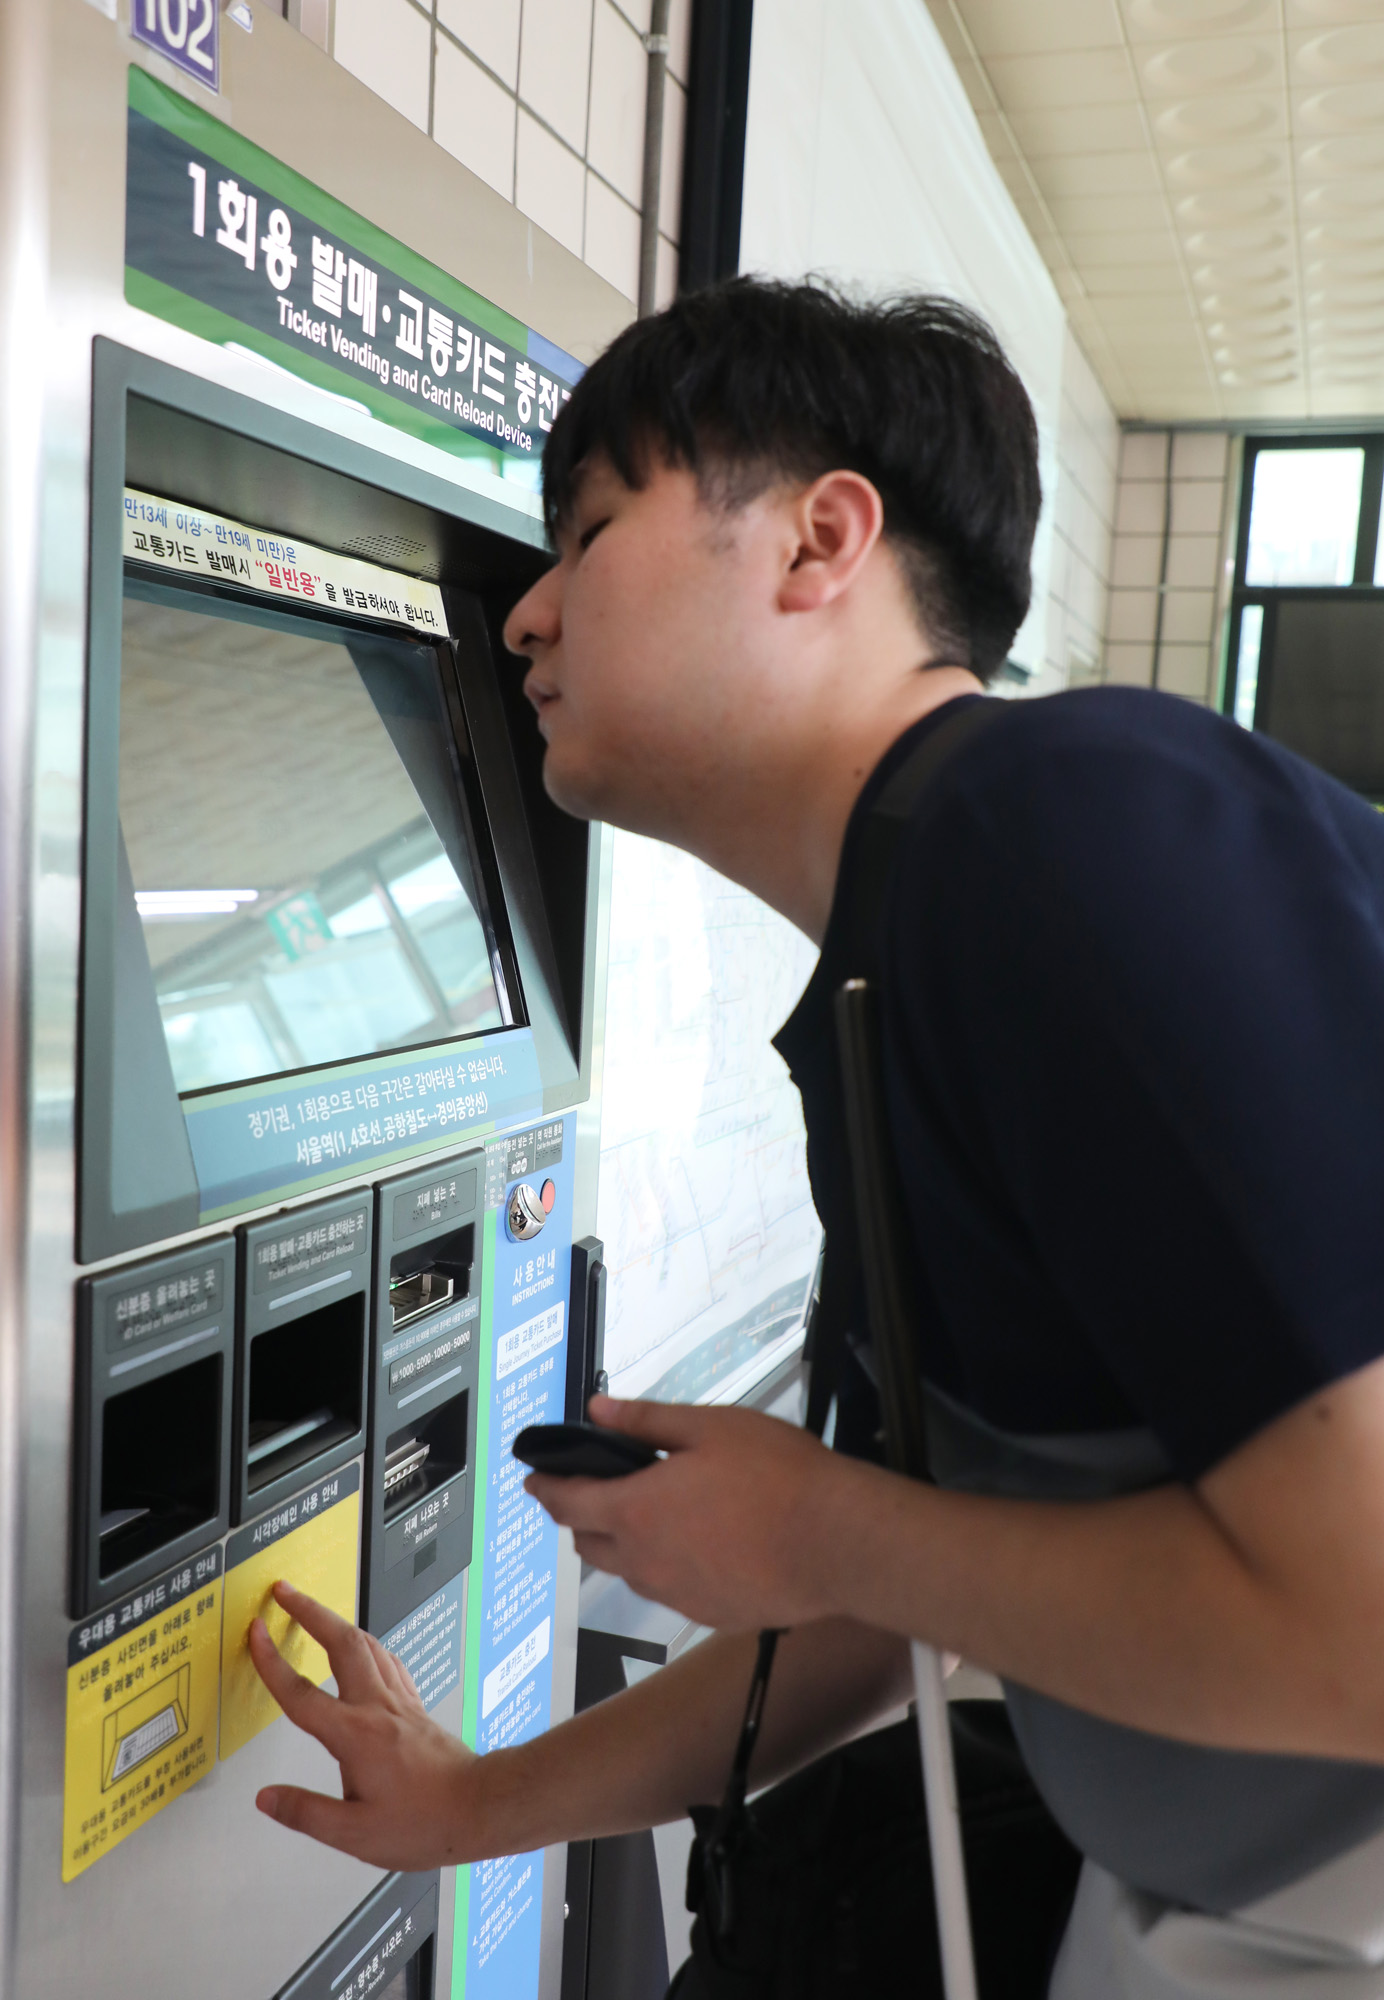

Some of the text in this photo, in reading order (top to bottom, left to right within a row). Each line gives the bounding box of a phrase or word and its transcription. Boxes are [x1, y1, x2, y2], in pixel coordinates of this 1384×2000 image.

[189, 162, 297, 290] 1회용
[514, 361, 571, 433] 충전
[277, 296, 532, 452] Ticket Vending and Card Reload Device
[124, 498, 168, 529] 만13세
[257, 538, 297, 564] 미만)은
[132, 530, 199, 565] 교통카드
[205, 549, 251, 580] 발매시
[343, 587, 399, 617] 발급하셔야
[404, 604, 439, 627] 합니다.
[248, 1053, 508, 1139] 정기권, 1회용으로 다음 구간은 갈아타실 수 없습니다.
[417, 1181, 456, 1207] 지폐 넣는 곳
[431, 1210, 441, 1220] Bills
[258, 1242, 278, 1263] 1회용
[328, 1218, 355, 1240] 충전하는
[357, 1214, 364, 1231] 곳
[268, 1241, 354, 1281] Ticket Vending and Card Reload
[116, 1269, 215, 1320] 신분증 올려놓는 곳
[511, 1274, 554, 1306] INSTRUCTIONS
[134, 1321, 153, 1336] Card
[153, 1318, 161, 1328] or
[190, 1300, 208, 1314] Card
[505, 1334, 520, 1354] 1회용
[522, 1319, 544, 1343] 교통카드
[498, 1329, 562, 1373] Single Journey Ticket Purchase
[502, 1382, 516, 1400] 1회용
[518, 1368, 538, 1390] 교통카드
[500, 1430, 515, 1447] Select
[252, 1480, 339, 1543] 시각장애인 사용 안내
[404, 1491, 449, 1534] 지폐 나오는 곳
[497, 1495, 512, 1513] Select
[415, 1522, 438, 1544] Bill Return
[494, 1531, 543, 1580] Insert bills or coins and
[78, 1553, 216, 1649] 우대용 교통카드 사용 안내
[494, 1594, 507, 1615] 1회용
[79, 1658, 111, 1691] 신분증
[163, 1608, 191, 1635] 아래로
[492, 1632, 503, 1648] Take
[503, 1624, 511, 1637] the
[103, 1635, 192, 1703] 올려놓아 주십시오.
[499, 1650, 523, 1681] 교통카드
[382, 1930, 402, 1959] 나오는
[404, 1916, 412, 1934] 곳
